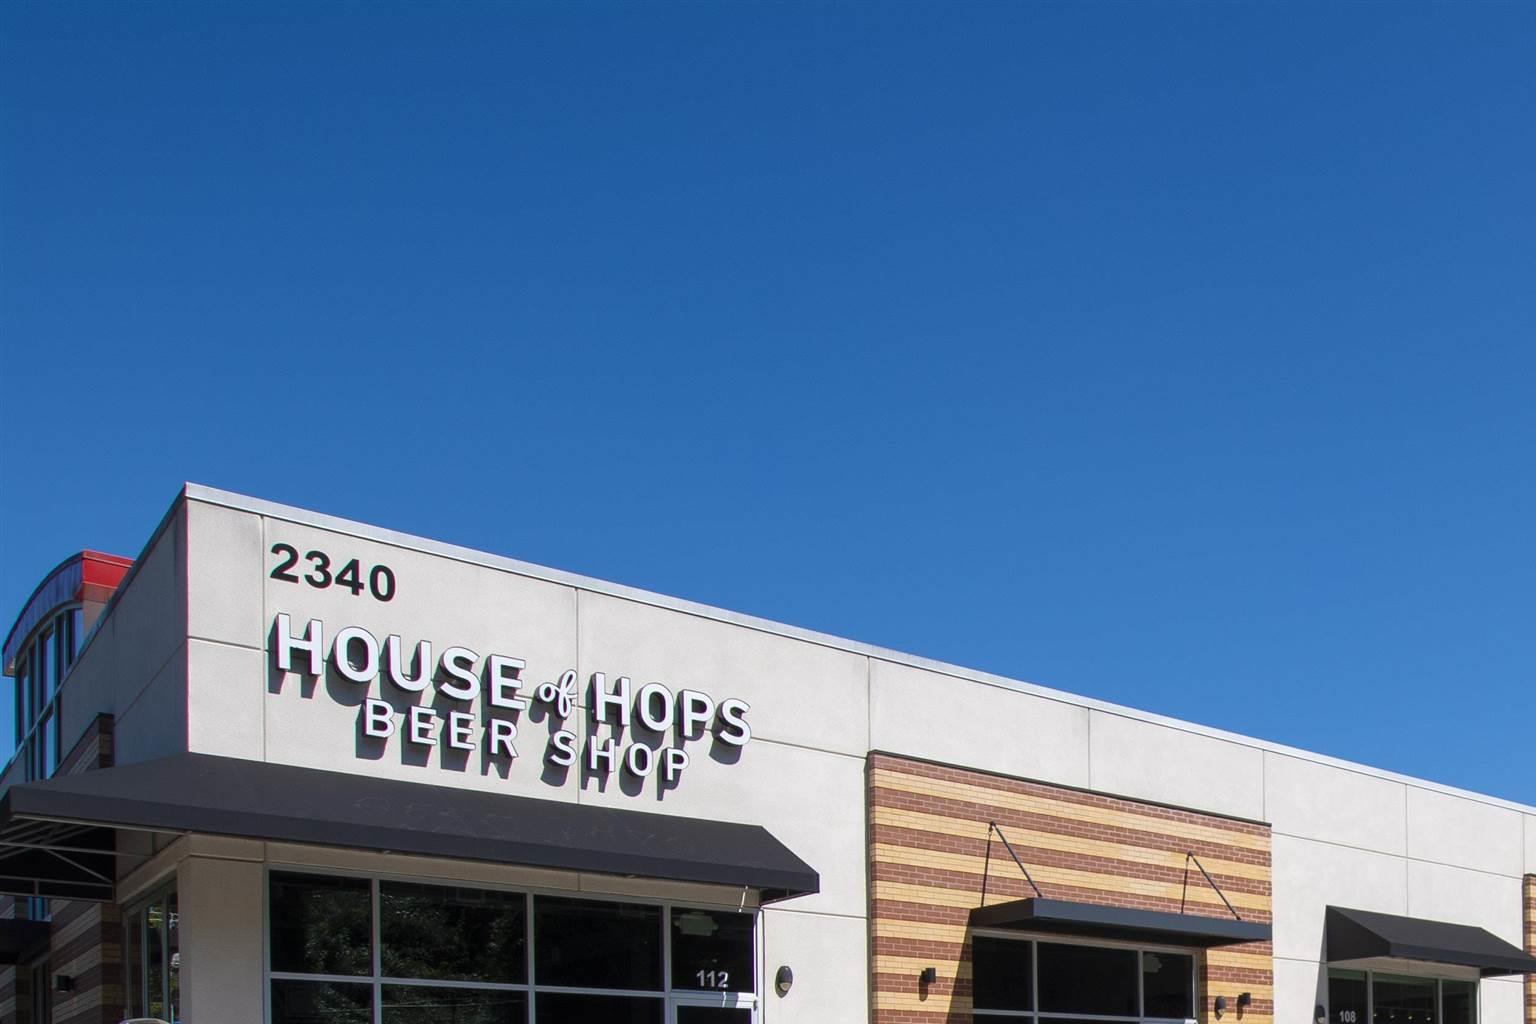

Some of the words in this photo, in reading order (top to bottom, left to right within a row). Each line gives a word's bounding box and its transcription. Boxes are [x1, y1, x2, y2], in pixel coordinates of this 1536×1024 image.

[270, 543, 396, 602] 2340
[275, 612, 527, 711] HOUSE
[538, 669, 577, 719] of
[592, 672, 752, 746] HOPS
[364, 697, 518, 758] BEER
[549, 730, 690, 781] SHOP
[696, 970, 729, 988] 112
[1339, 1010, 1356, 1023] 108
